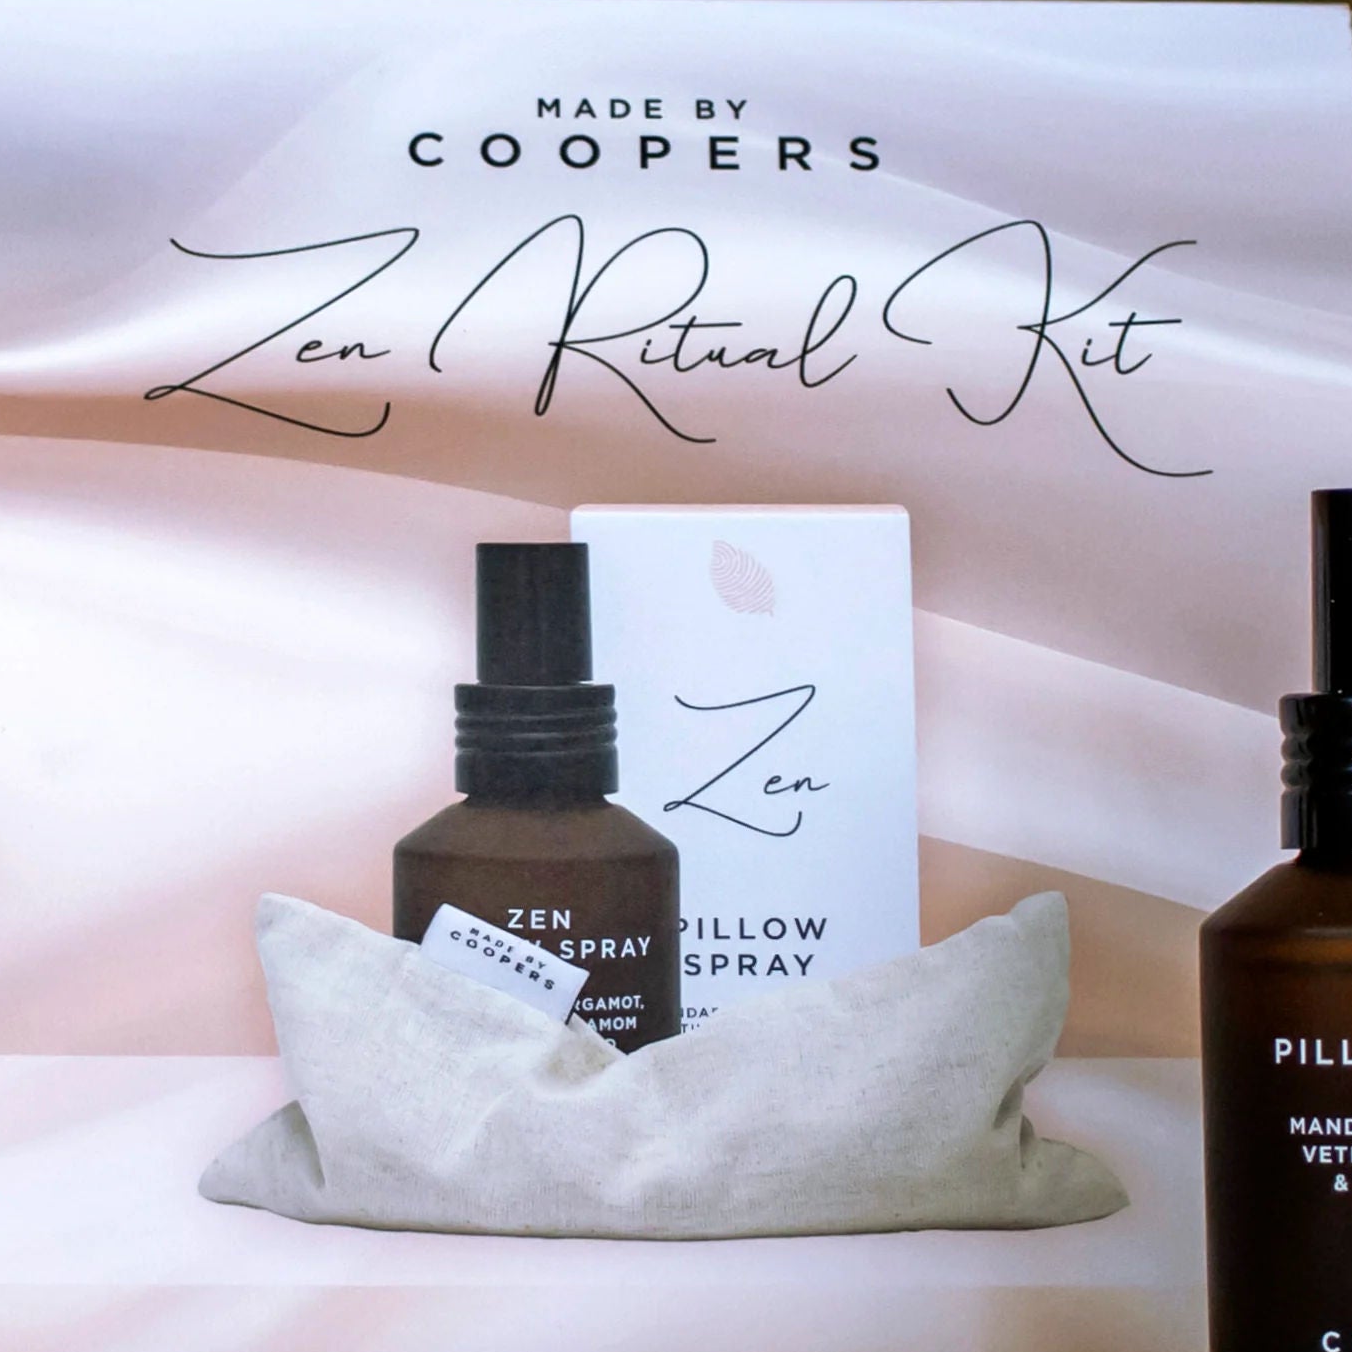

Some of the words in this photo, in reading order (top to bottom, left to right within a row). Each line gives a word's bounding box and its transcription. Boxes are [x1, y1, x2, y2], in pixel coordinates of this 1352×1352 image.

[536, 97, 664, 120] MADE
[695, 98, 749, 120] BY
[407, 131, 881, 172] COOPERS
[143, 227, 420, 438] Zen
[428, 213, 858, 444] Ritual
[881, 219, 1214, 478] Kit
[663, 684, 830, 838] Zen
[507, 908, 572, 930] ZEN
[449, 929, 556, 991] COOPERS
[469, 926, 515, 954] MADE
[524, 955, 547, 970] BY
[559, 935, 652, 960] SPRAY
[683, 953, 815, 977] SPRAY
[587, 1015, 638, 1032] AMOM
[1333, 1173, 1349, 1192] &
